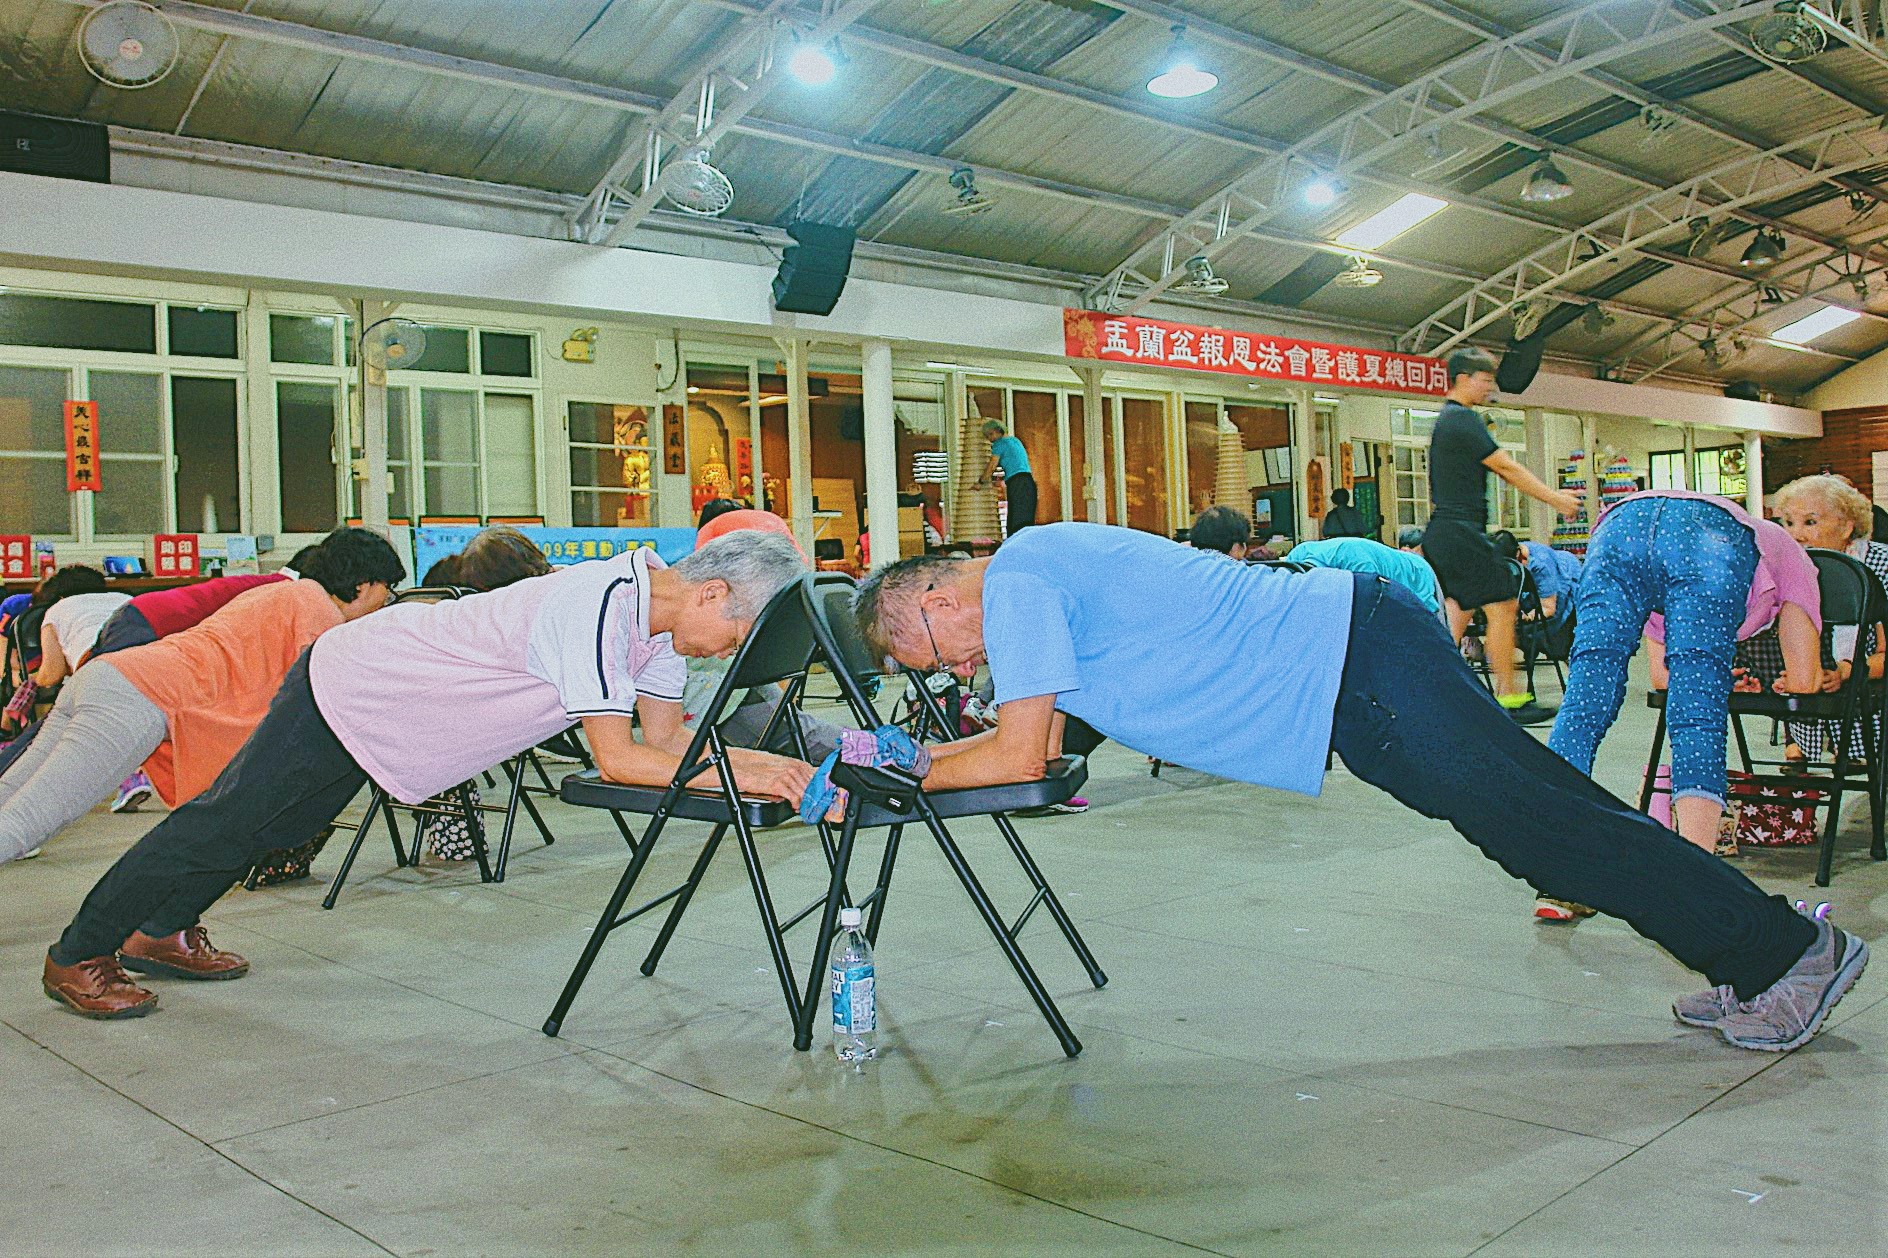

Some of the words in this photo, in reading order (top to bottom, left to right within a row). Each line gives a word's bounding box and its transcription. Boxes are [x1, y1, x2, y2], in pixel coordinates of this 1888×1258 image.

[1101, 320, 1449, 393] 盂蘭盆報恩法會暨護夏總回向
